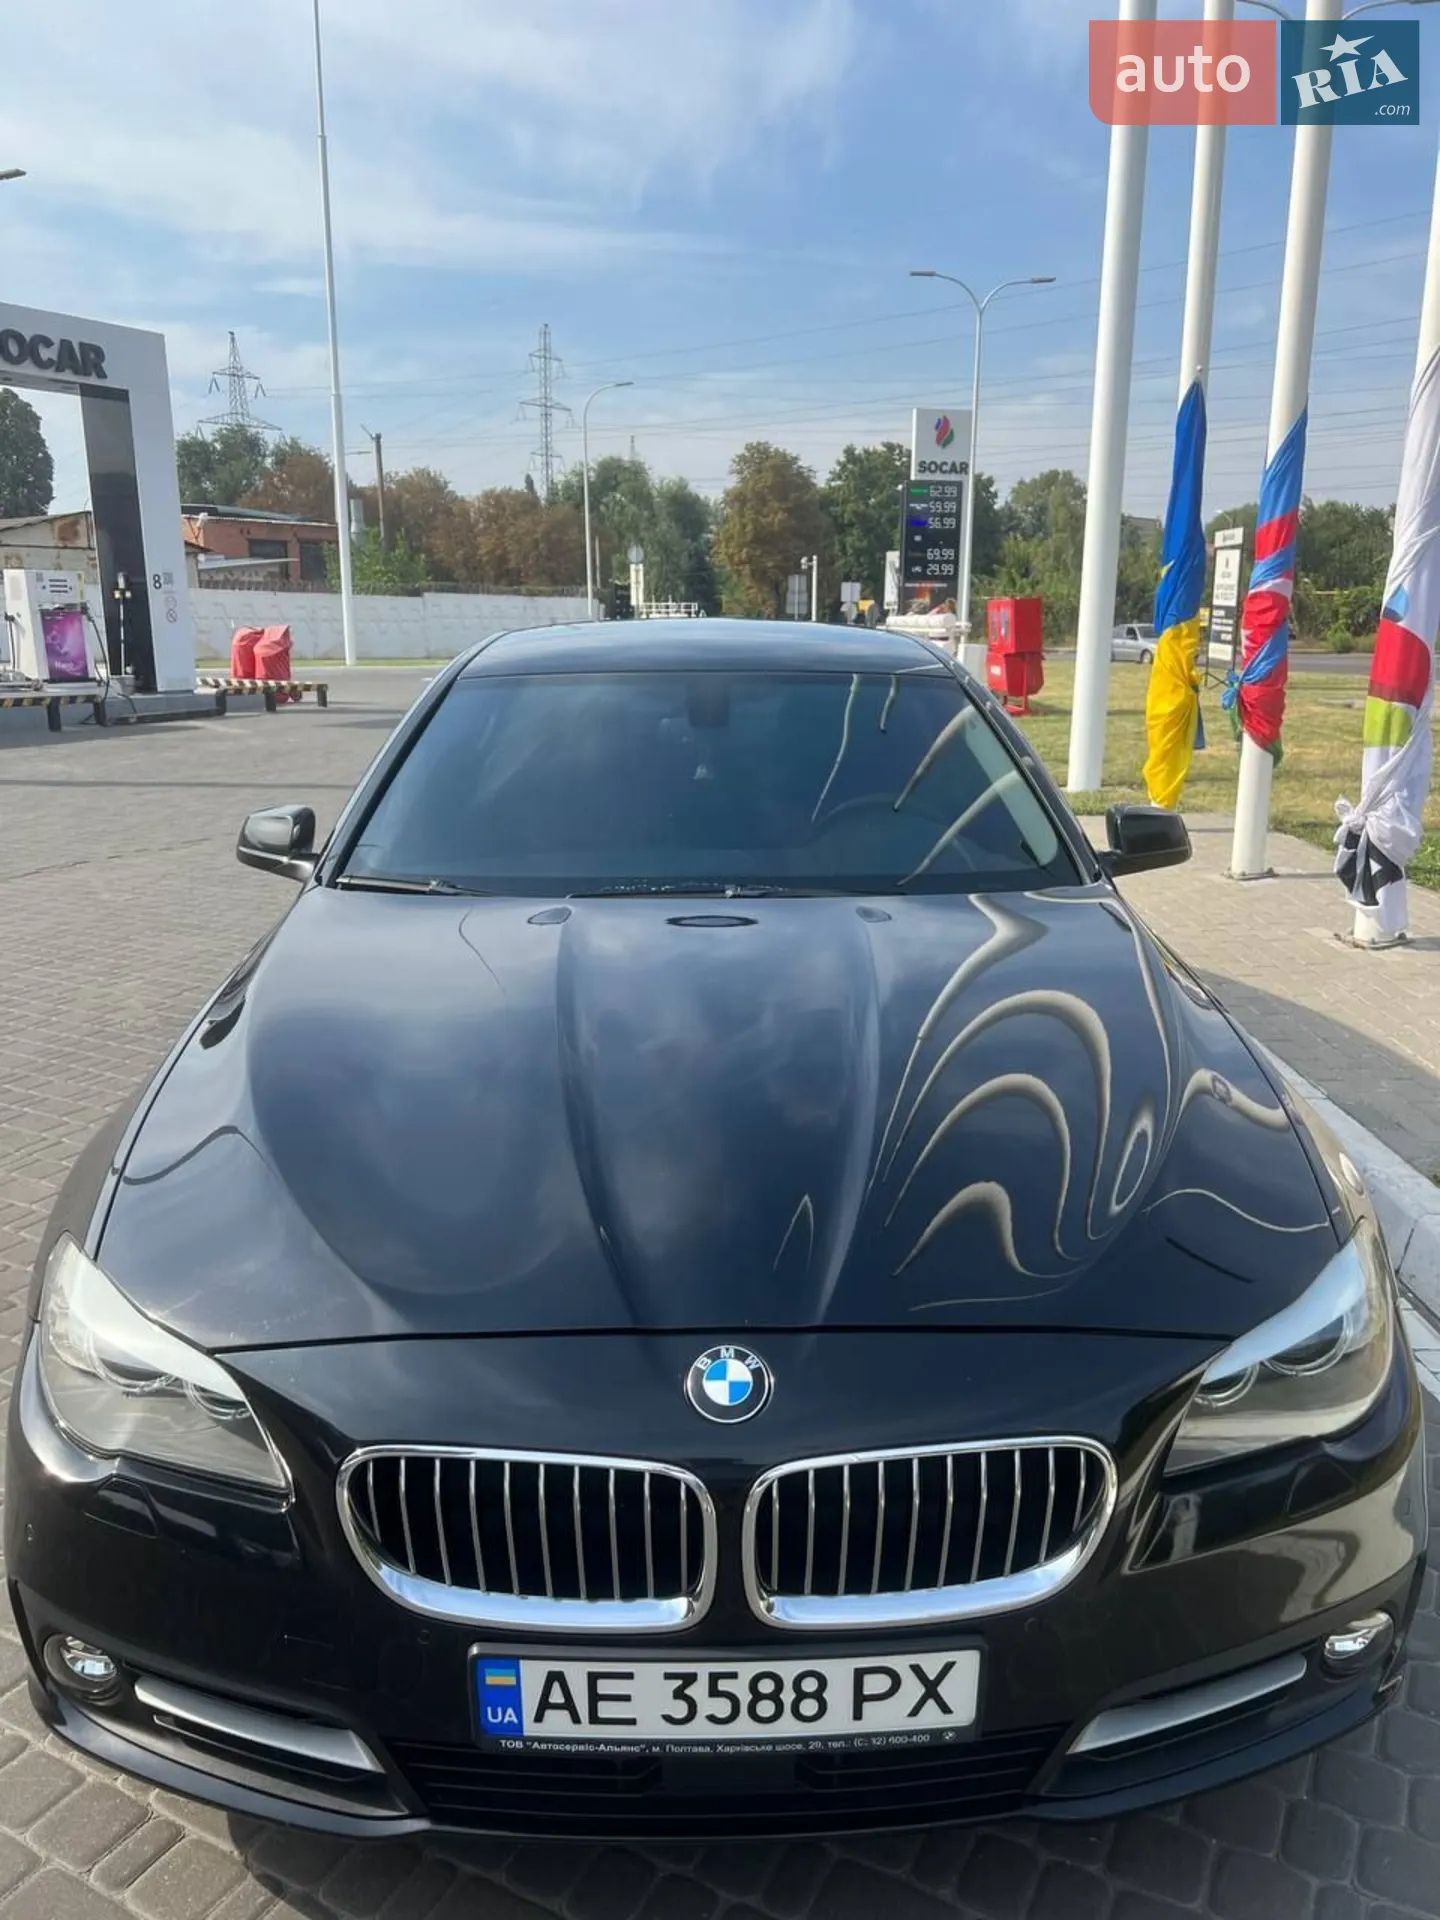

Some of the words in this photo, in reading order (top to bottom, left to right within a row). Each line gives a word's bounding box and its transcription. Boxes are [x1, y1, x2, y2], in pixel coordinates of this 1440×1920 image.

[917, 460, 969, 475] SOCAR
[929, 485, 957, 497] 62.99
[928, 501, 957, 513] 59.99
[928, 517, 956, 529] 56.99
[926, 548, 955, 560] 69.99
[926, 563, 954, 575] 29.99
[152, 573, 162, 590] 8
[696, 1347, 761, 1370] BMW
[533, 1670, 637, 1726] AE
[660, 1669, 829, 1726] 3588
[852, 1661, 957, 1722] PX
[487, 1707, 519, 1724] UA
[499, 1739, 524, 1749] ТОВ
